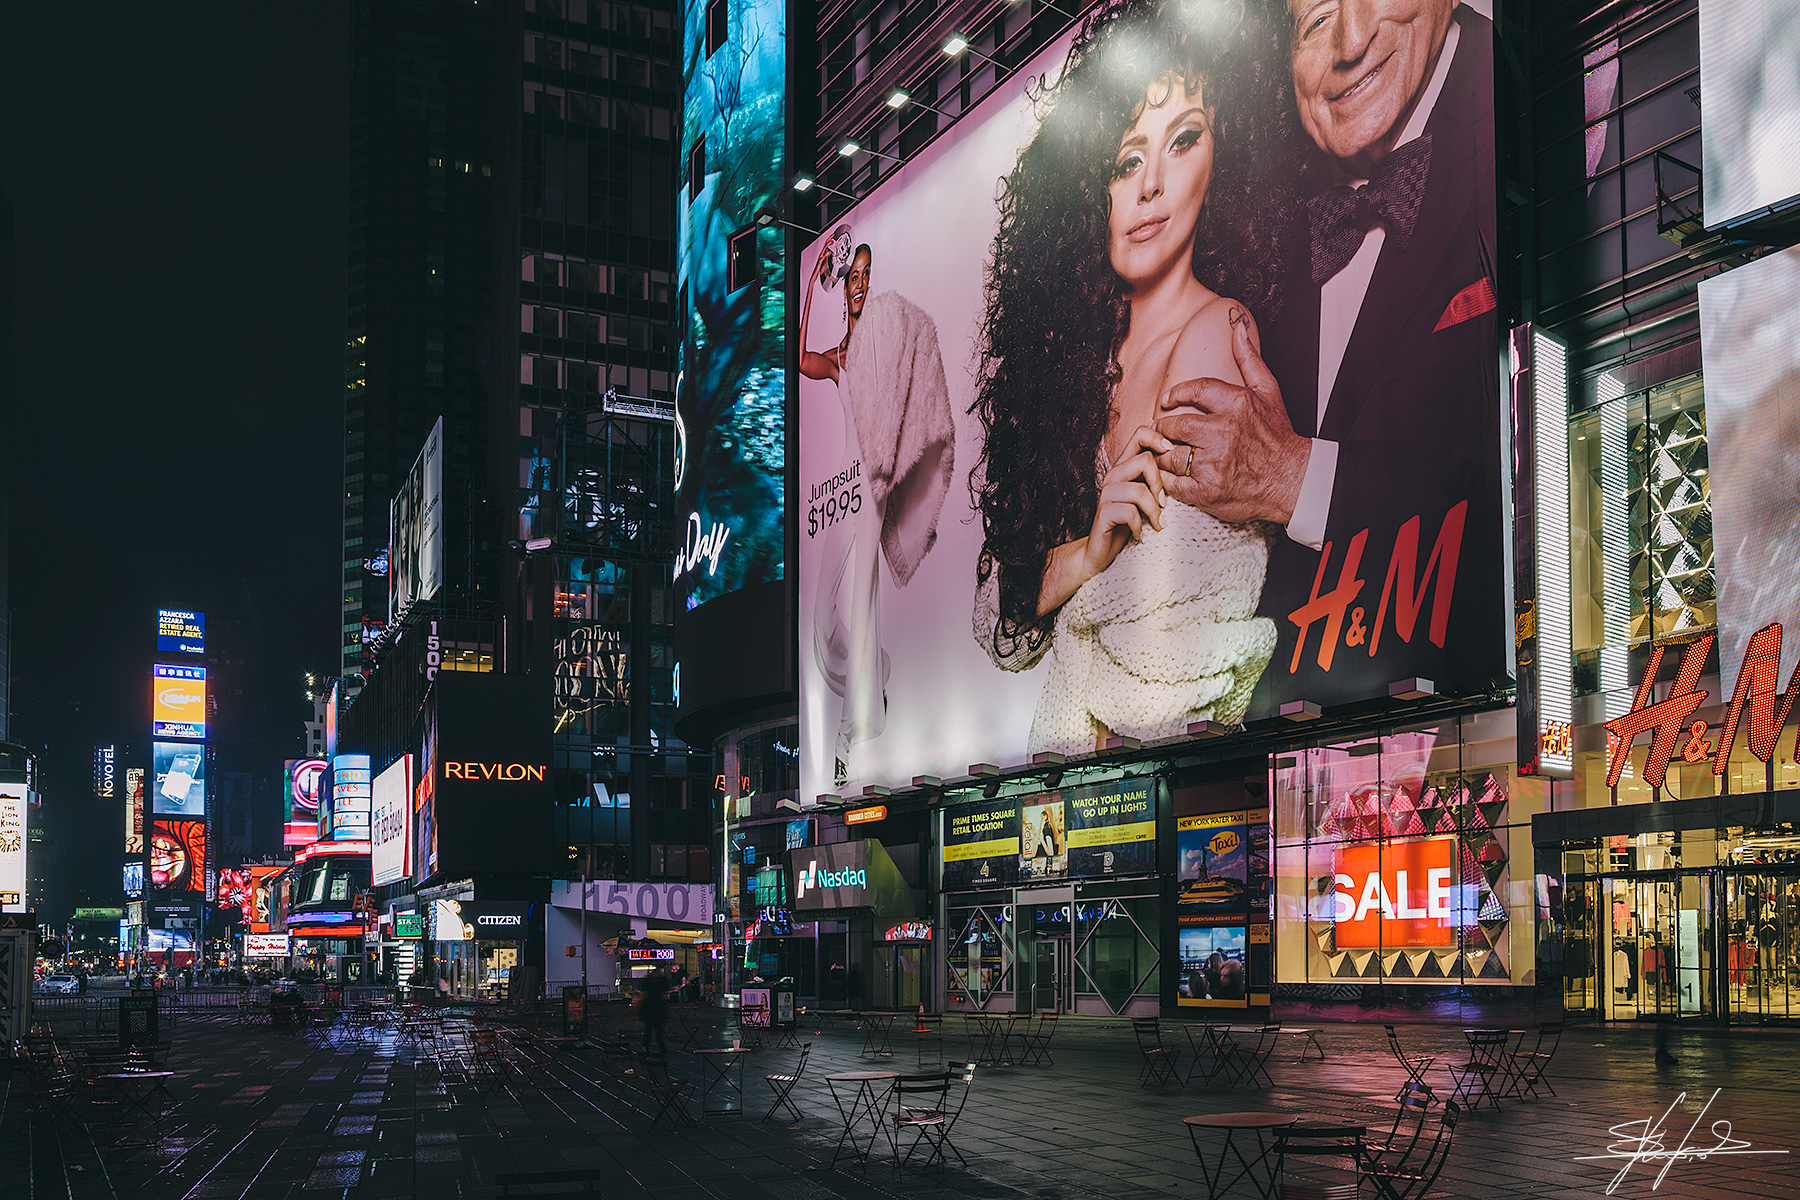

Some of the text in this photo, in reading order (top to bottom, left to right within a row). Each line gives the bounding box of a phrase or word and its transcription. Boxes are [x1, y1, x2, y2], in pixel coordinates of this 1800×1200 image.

[807, 460, 861, 503] Jumpsuit
[807, 483, 862, 539] $19.95
[686, 511, 730, 577] Day
[1287, 499, 1468, 674] H&M
[159, 610, 195, 619] FRANCESCA
[159, 623, 184, 631] RETIRED
[1602, 622, 1800, 788] H&M
[164, 723, 195, 732] XINHUA
[1541, 720, 1572, 760] H&M
[102, 744, 115, 798] NOVOTEL
[341, 771, 362, 781] KID
[444, 761, 543, 782] REVLON
[1071, 790, 1147, 808] WATCH YOUR NAME
[1083, 801, 1147, 818] GO UP IN LIGHTS
[952, 809, 1016, 826] PRIME TIMES SQUARE
[1179, 820, 1192, 828] NEW
[1194, 818, 1210, 826] YORK
[1210, 816, 1230, 824] WATER
[1230, 814, 1244, 822] TAXI
[952, 821, 1004, 836] RETAIL LOCATION
[1210, 831, 1238, 852] Taxi!
[817, 865, 867, 890] Nasdaq
[585, 884, 690, 921] 1500
[1335, 868, 1451, 923] SALE
[477, 915, 522, 926] CITIZEN
[1684, 982, 1693, 1003] 1
